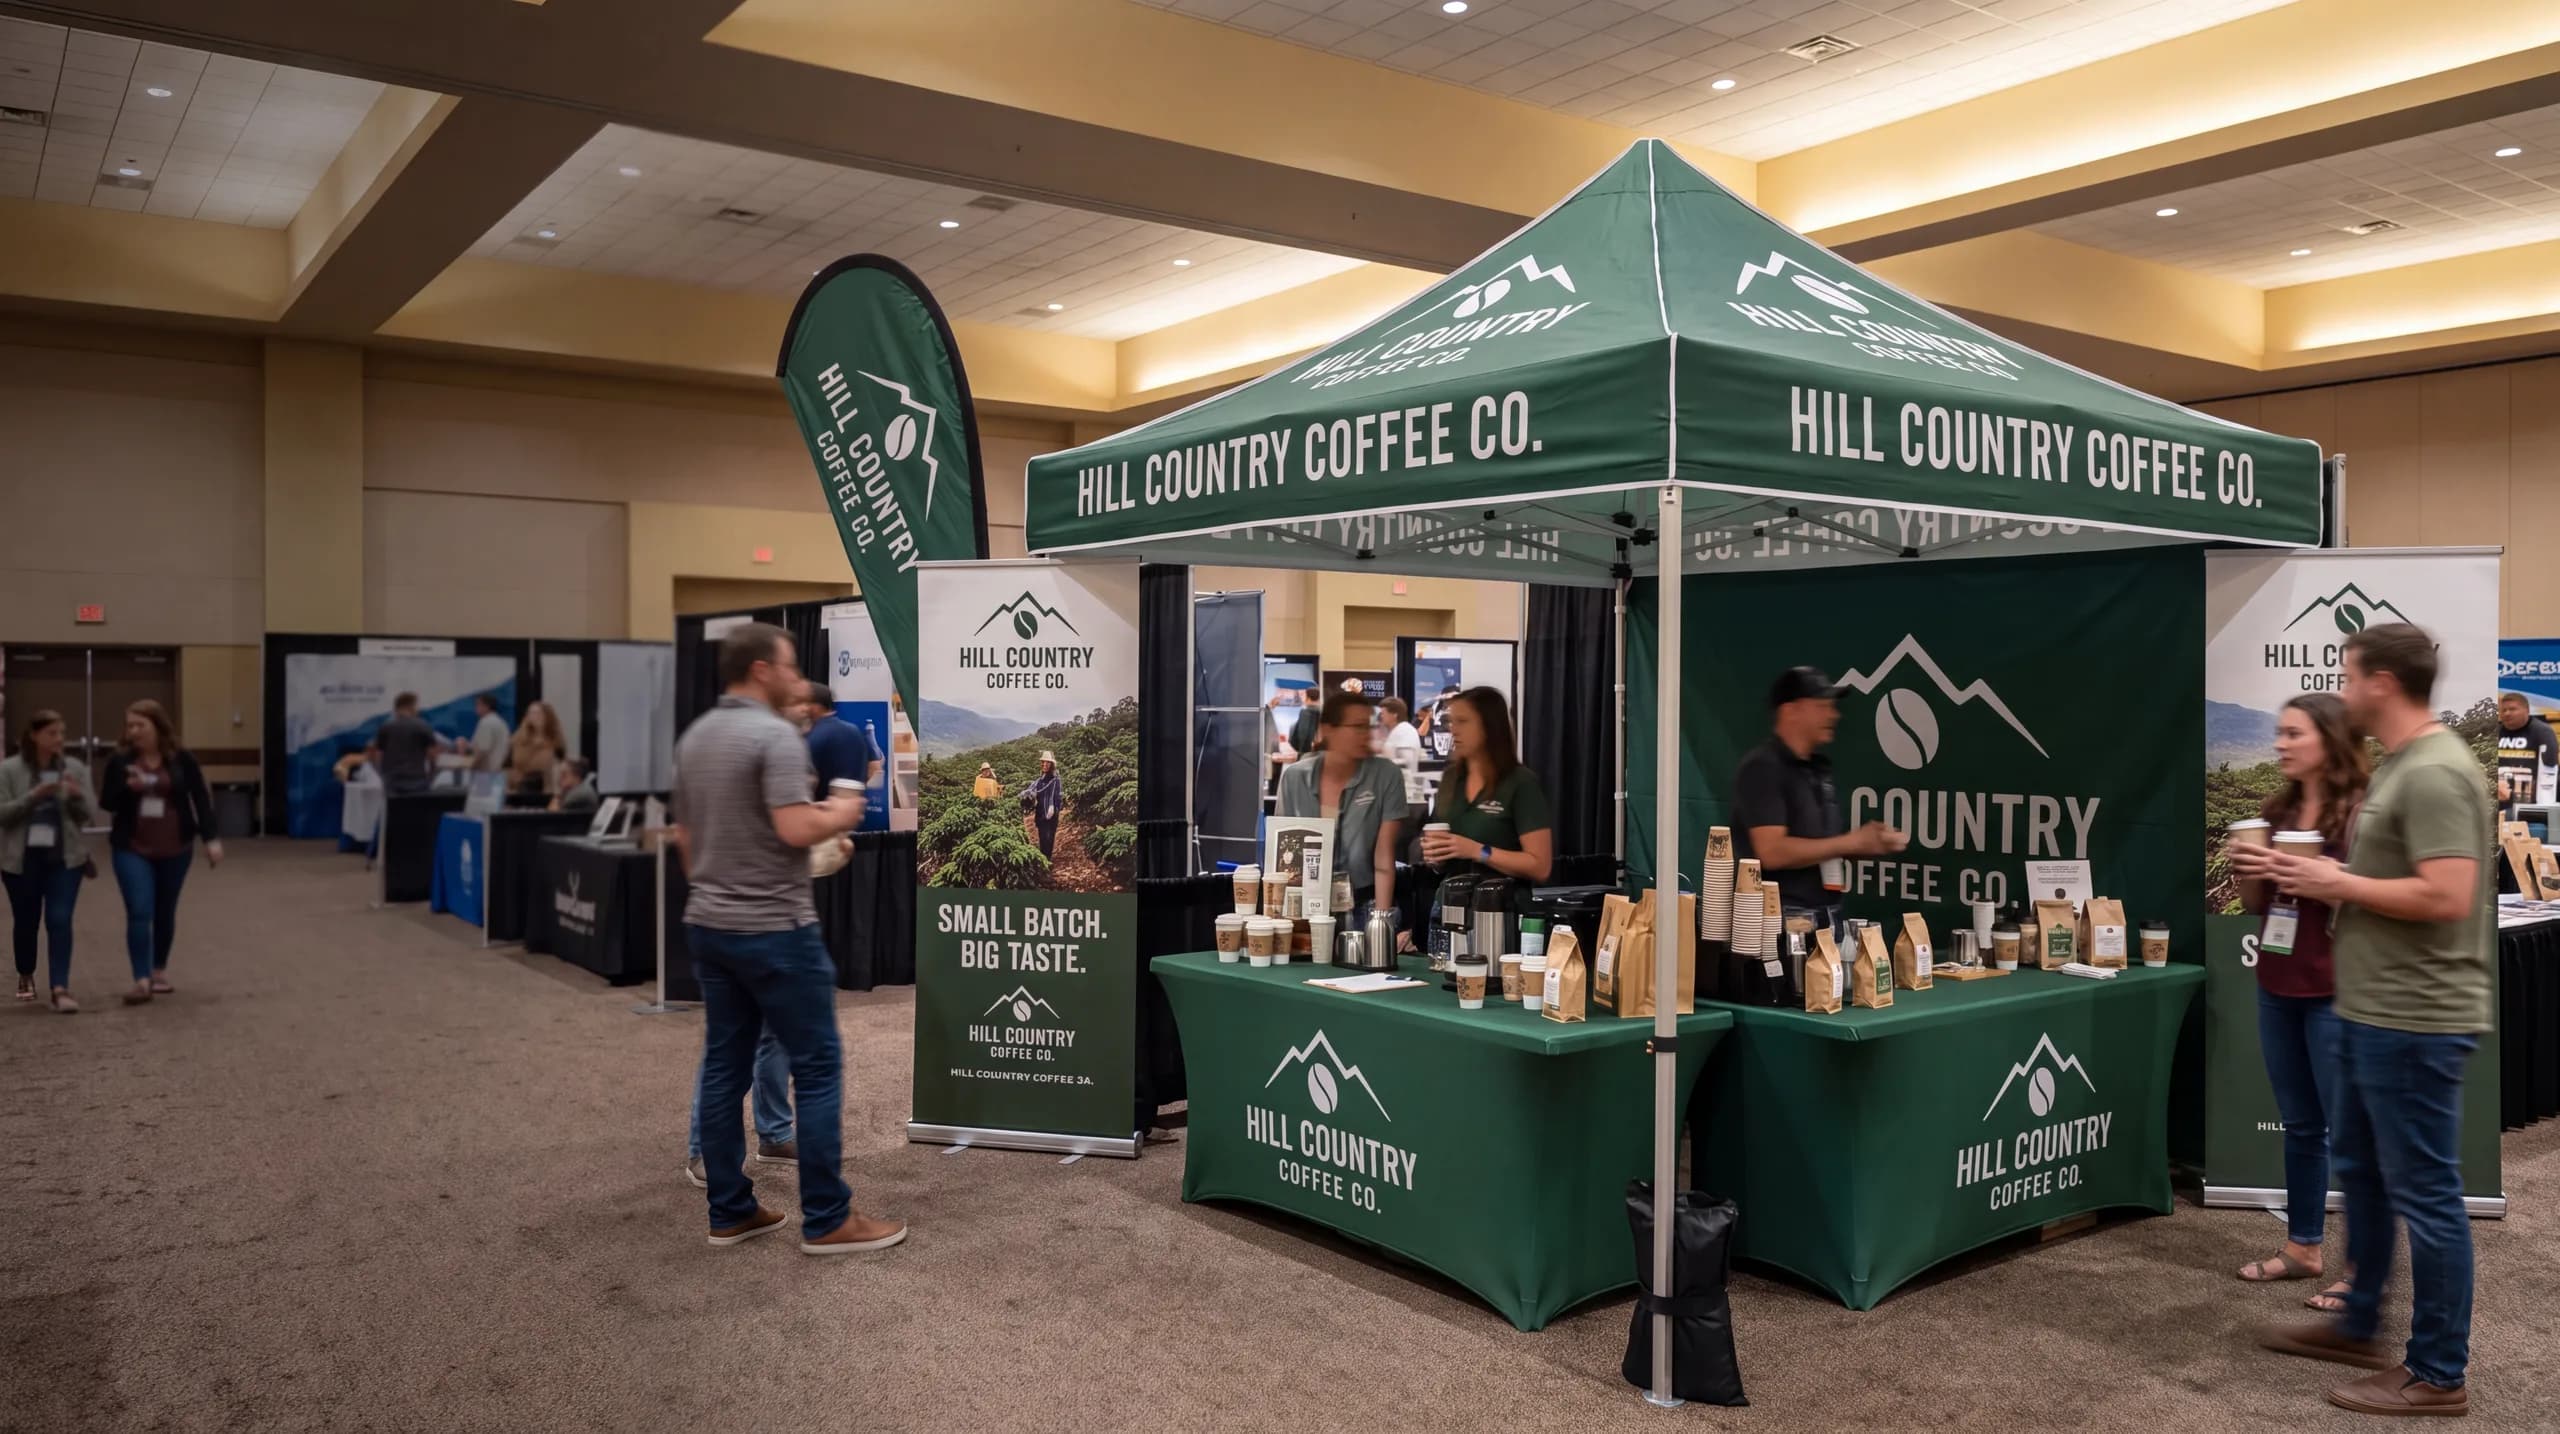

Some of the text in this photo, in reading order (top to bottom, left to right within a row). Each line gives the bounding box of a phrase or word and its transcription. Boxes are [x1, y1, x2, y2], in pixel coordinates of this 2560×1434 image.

[1290, 301, 1592, 383] HILL COUNTRY
[1725, 301, 2025, 370] HILL COUNTRY
[1310, 355, 1425, 390] COFFEE
[1851, 342, 1974, 372] COFFEE
[1078, 390, 1543, 517] HILL COUNTRY COFFEE CO.
[1791, 386, 2263, 508] HILL COUNTRY COFFEE CO.
[817, 362, 920, 574] HILL COUNTRY
[817, 430, 875, 554] COFFEE CO.
[960, 646, 1094, 668] HILL COUNTRY
[2264, 644, 2314, 667] HILL
[987, 673, 1068, 689] COFFEE CO.
[1850, 786, 2101, 859] COUNTRY
[938, 904, 1107, 939] SMALL BATCH.
[961, 940, 1086, 973] BIG TASTE.
[969, 1024, 1076, 1047] HILL COUNTRY
[990, 1046, 1055, 1061] COFFEE CO.
[951, 1068, 974, 1077] HILL
[1033, 1073, 1074, 1084] COFFEE
[1247, 1104, 1417, 1191] HILL COUNTRY
[2257, 1122, 2287, 1132] HILL
[1957, 1111, 2112, 1188] HILL COUNTRY
[1279, 1158, 1381, 1214] COFFEE CO.
[1990, 1164, 2083, 1211] COFFEE CO.
